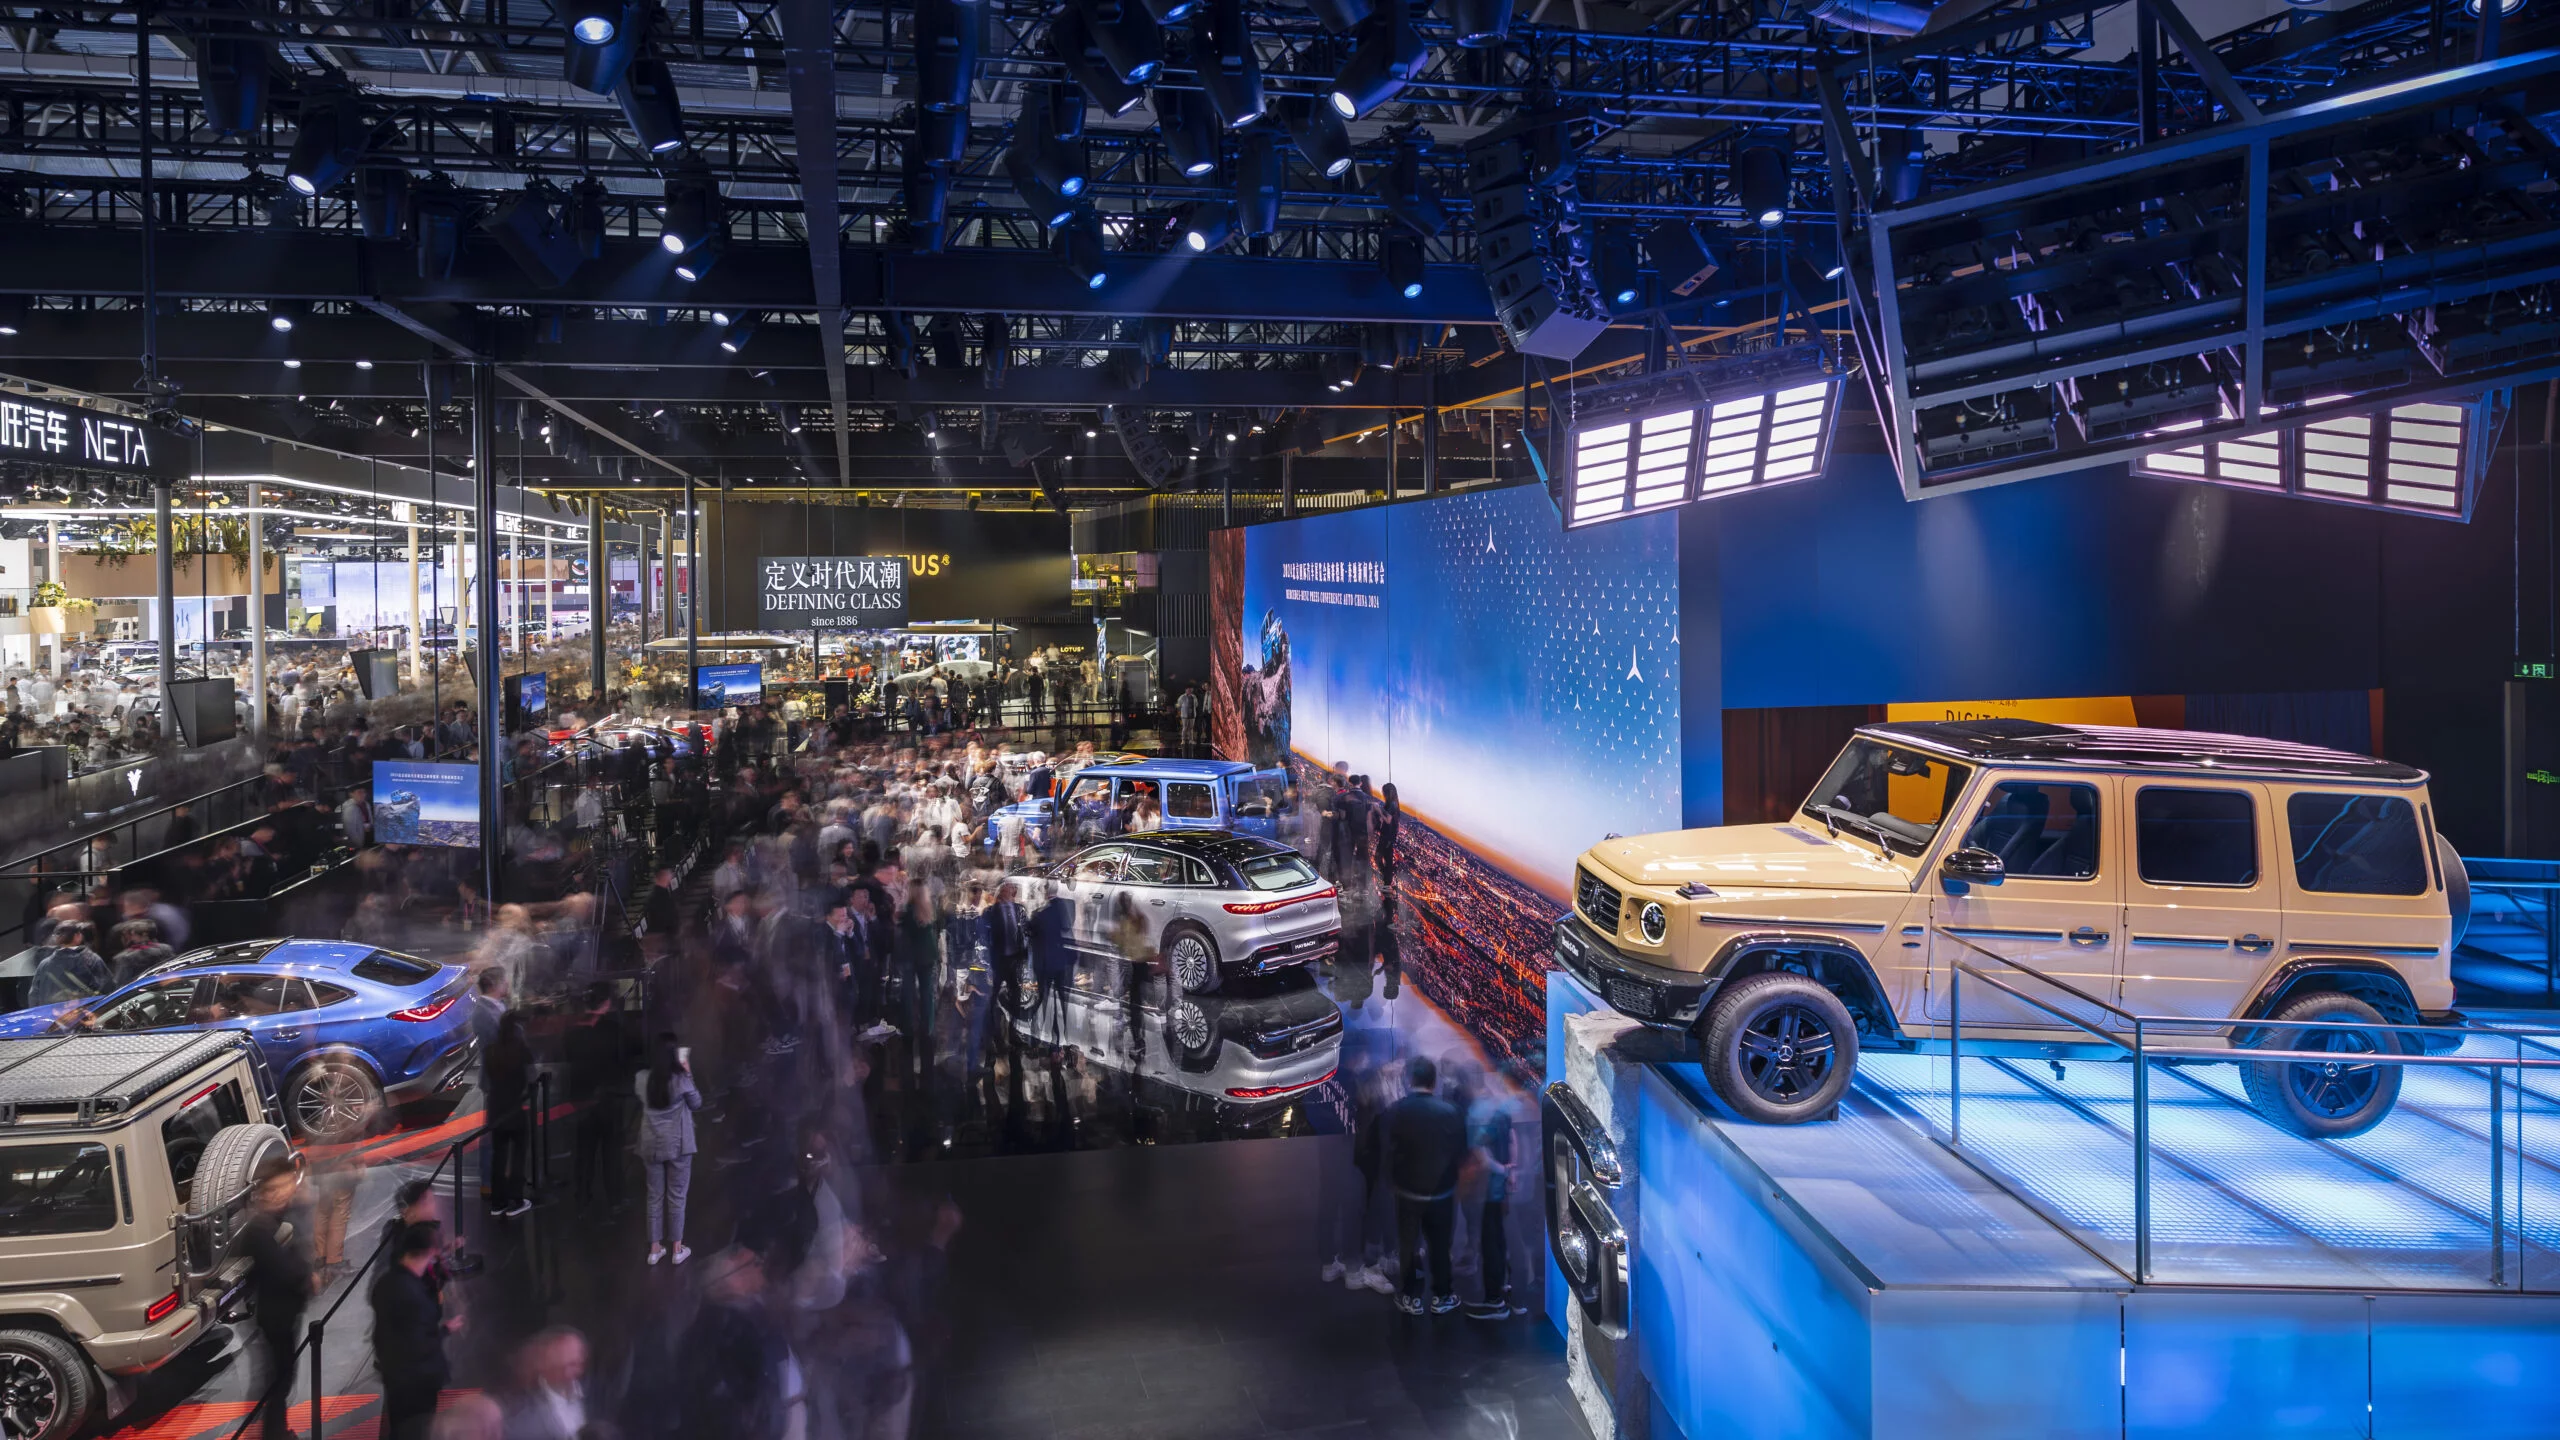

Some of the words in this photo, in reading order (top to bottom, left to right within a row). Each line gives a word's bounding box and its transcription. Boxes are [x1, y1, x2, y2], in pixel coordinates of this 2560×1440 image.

[84, 418, 149, 466] NETA
[765, 561, 901, 590] 定义时代风潮
[765, 593, 846, 611] DEFINING
[850, 592, 901, 610] CLASS
[811, 616, 835, 626] since
[837, 615, 858, 626] 1886
